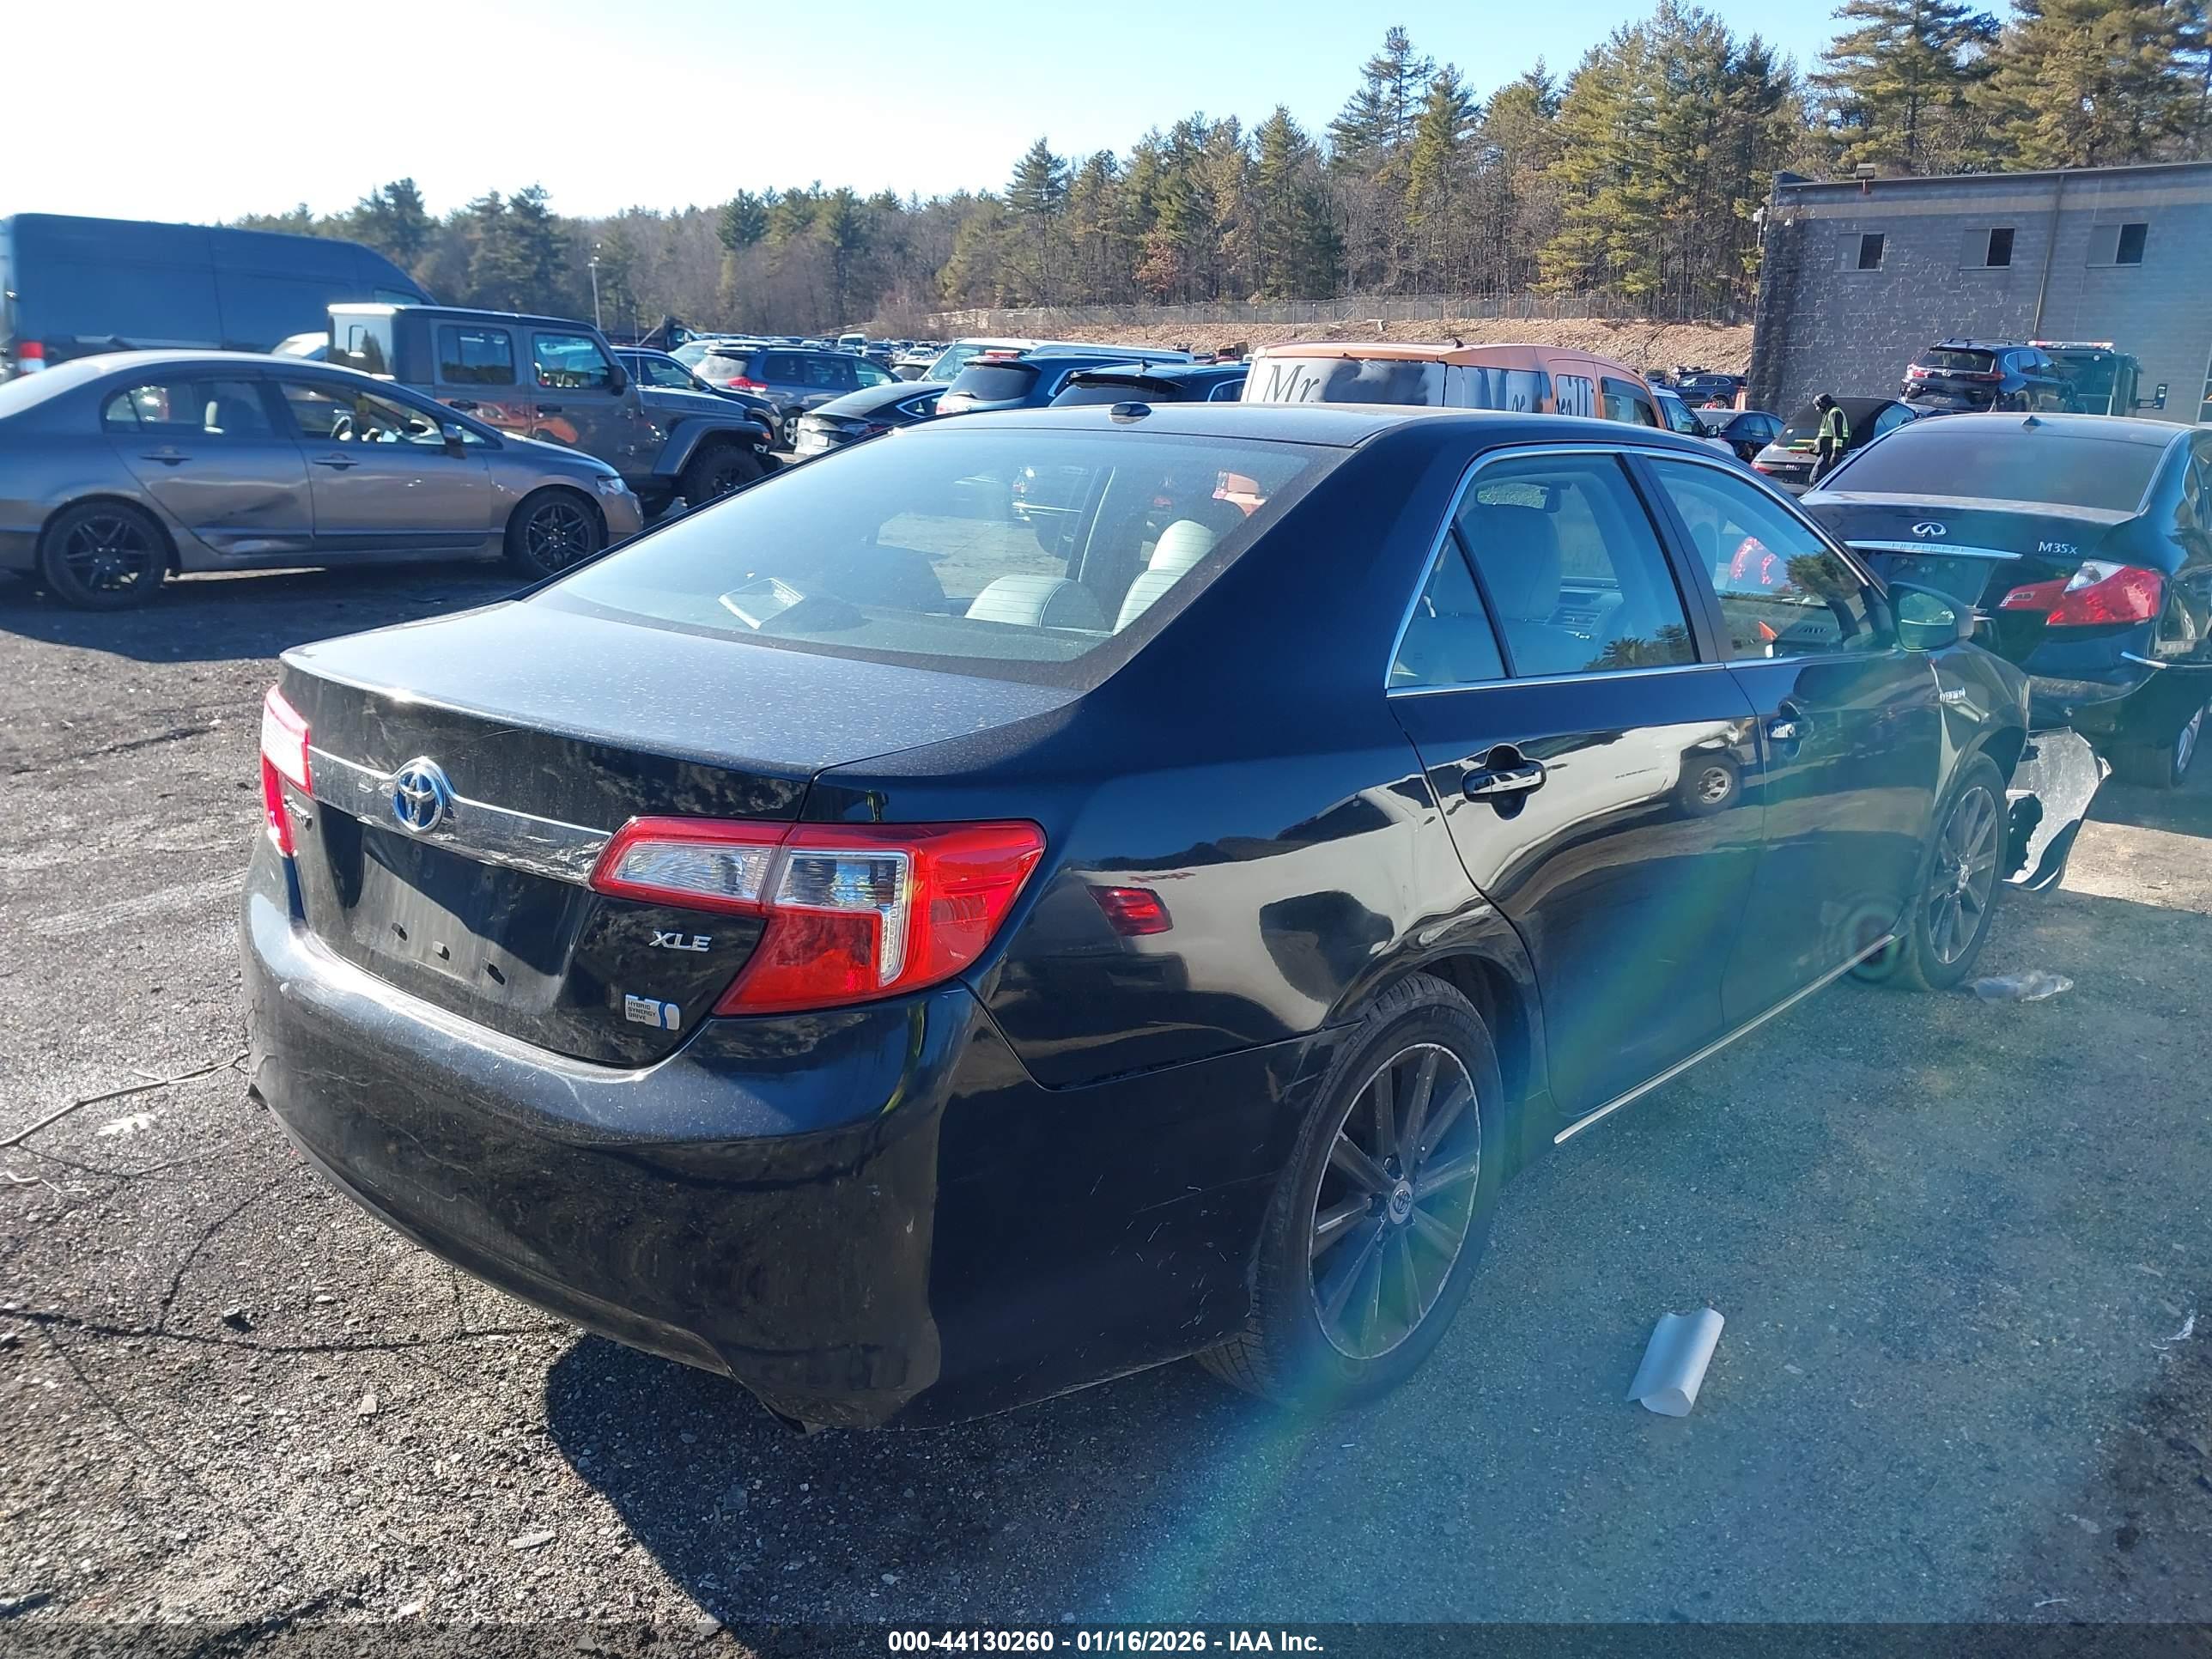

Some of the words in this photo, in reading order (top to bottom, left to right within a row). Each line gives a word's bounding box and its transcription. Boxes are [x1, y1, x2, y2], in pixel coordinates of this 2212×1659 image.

[2038, 540, 2078, 555] M35x
[647, 930, 713, 953] XLE
[628, 1000, 651, 1011] HYBRID
[628, 1006, 657, 1018] SYNERGY
[628, 1012, 647, 1021] DRIVE
